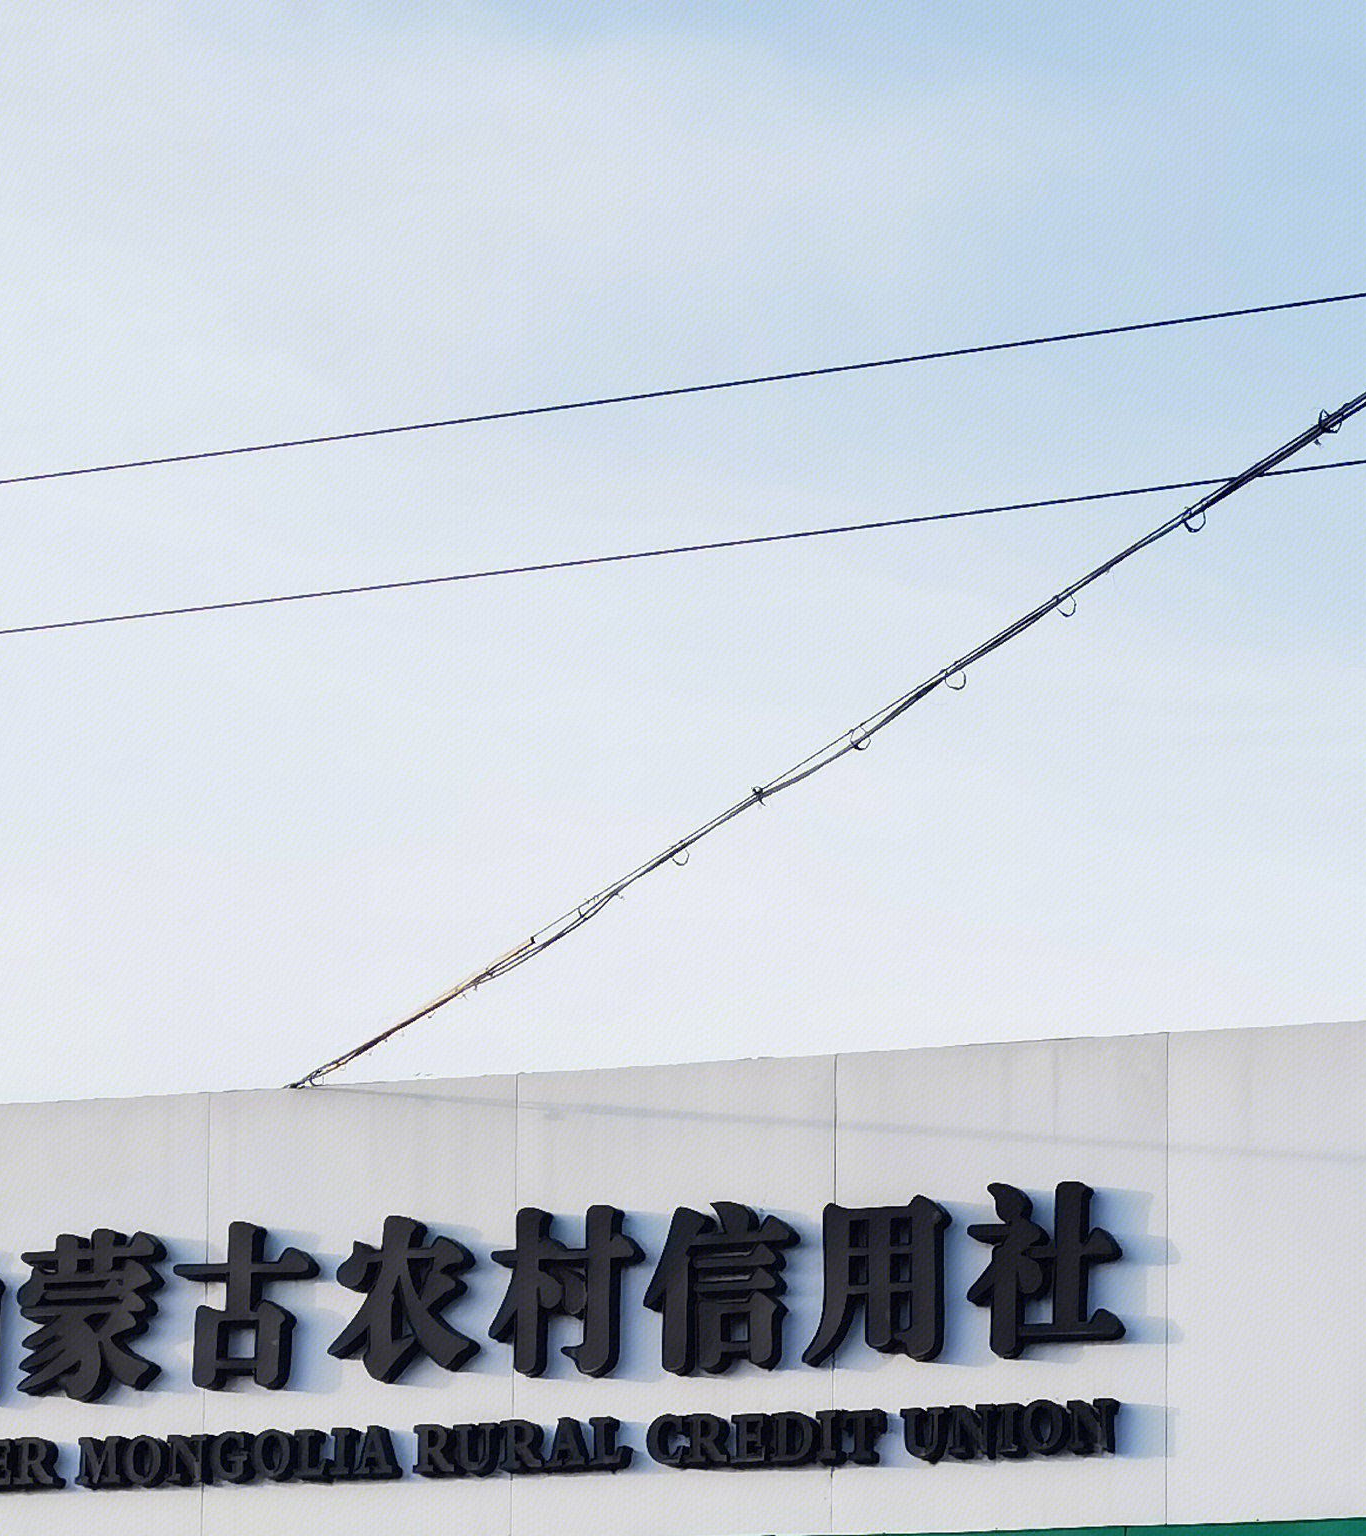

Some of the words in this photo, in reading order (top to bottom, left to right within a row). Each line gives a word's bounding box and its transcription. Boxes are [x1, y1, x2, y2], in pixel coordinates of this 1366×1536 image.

[75, 1424, 403, 1492] MONGOLIA
[413, 1415, 633, 1478] RURAL
[645, 1406, 889, 1471] CREDIT
[900, 1397, 1121, 1465] UNION
